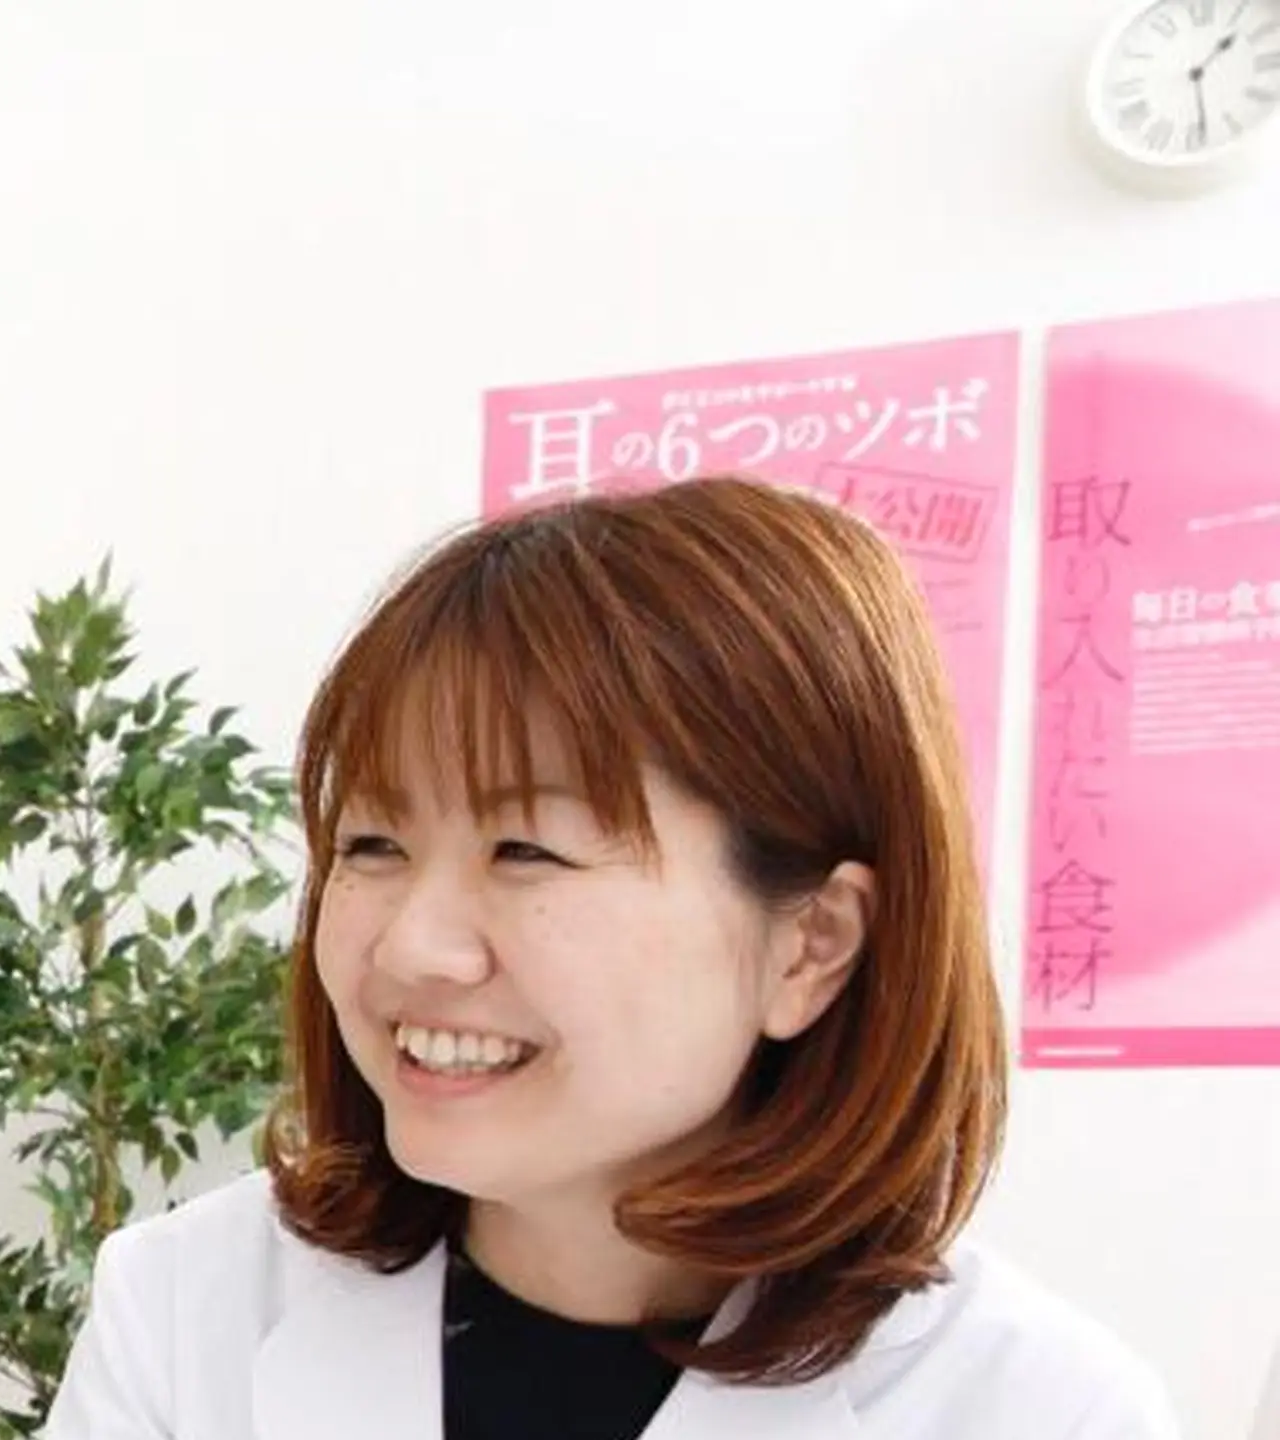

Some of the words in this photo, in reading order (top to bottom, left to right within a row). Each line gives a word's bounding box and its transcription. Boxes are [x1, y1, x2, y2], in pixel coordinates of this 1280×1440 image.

[507, 377, 991, 502] 耳の6つのツボ
[1031, 474, 1132, 1014] 取り入れたい食材
